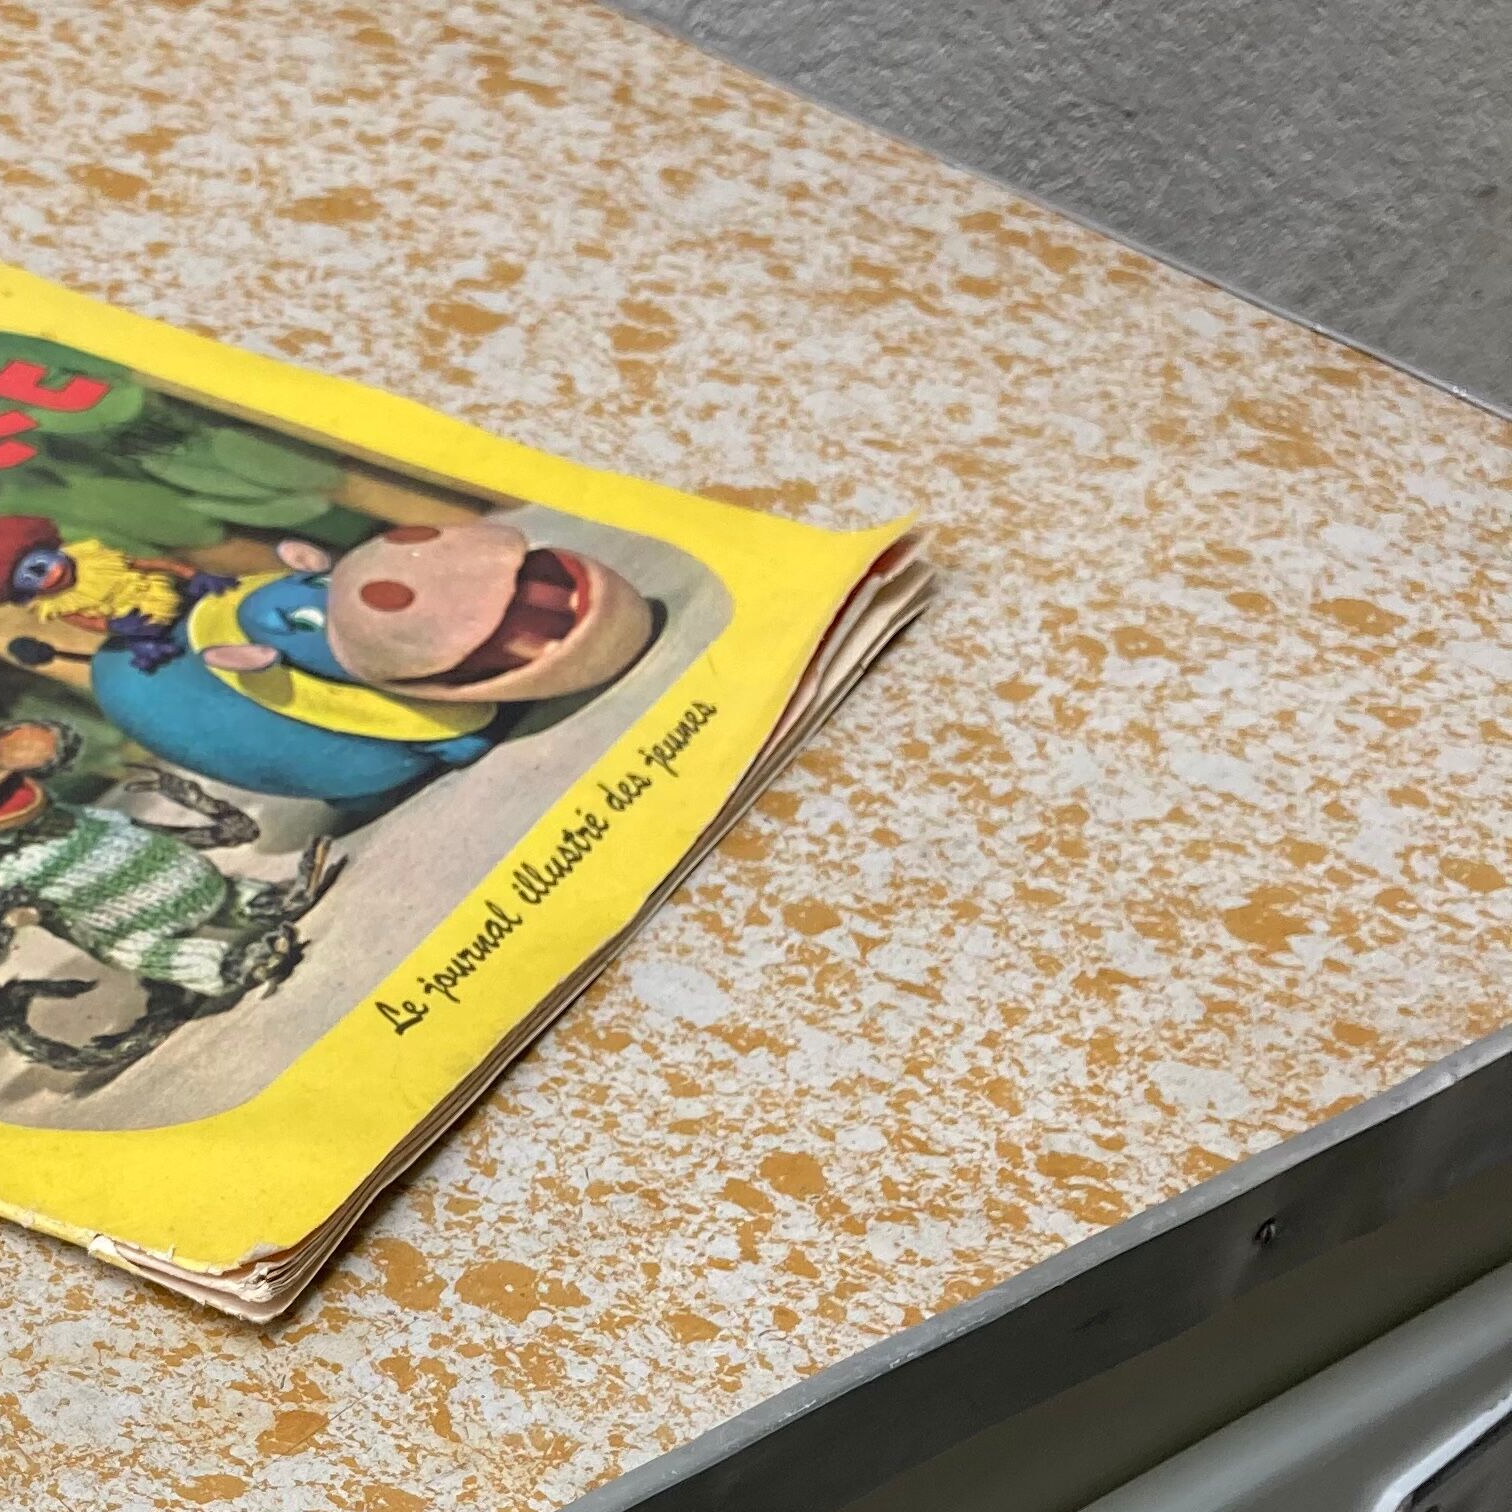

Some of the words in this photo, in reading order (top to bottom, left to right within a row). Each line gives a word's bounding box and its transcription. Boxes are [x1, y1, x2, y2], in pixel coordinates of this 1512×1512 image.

[374, 999, 429, 1036] Le
[417, 899, 523, 1004] journal
[511, 809, 611, 906] illustré
[597, 772, 653, 813] des
[638, 700, 719, 778] jeunes
